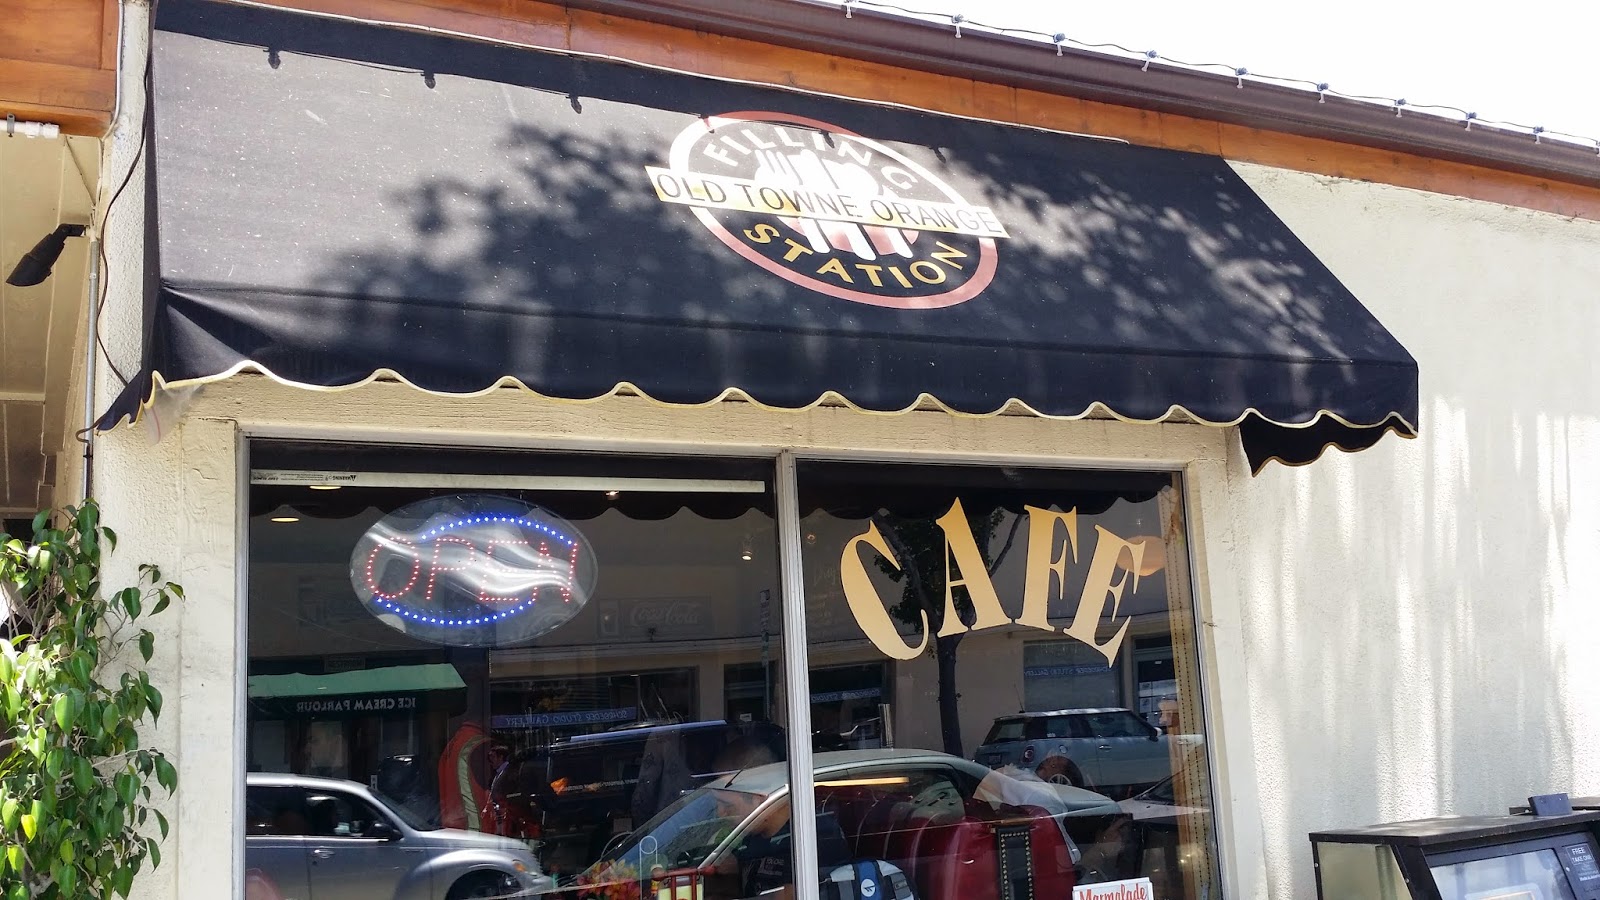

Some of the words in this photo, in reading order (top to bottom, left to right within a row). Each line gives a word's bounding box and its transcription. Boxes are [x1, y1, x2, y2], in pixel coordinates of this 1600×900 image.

[702, 125, 917, 190] FILLING
[656, 172, 728, 204] OLD
[734, 182, 862, 218] TOWNE
[870, 200, 1002, 233] ORANGE
[743, 222, 968, 288] STATION
[367, 536, 578, 602] OPEN
[840, 497, 1146, 668] CAFE
[1571, 847, 1586, 855] FREE
[1079, 882, 1148, 900] Marmalade
